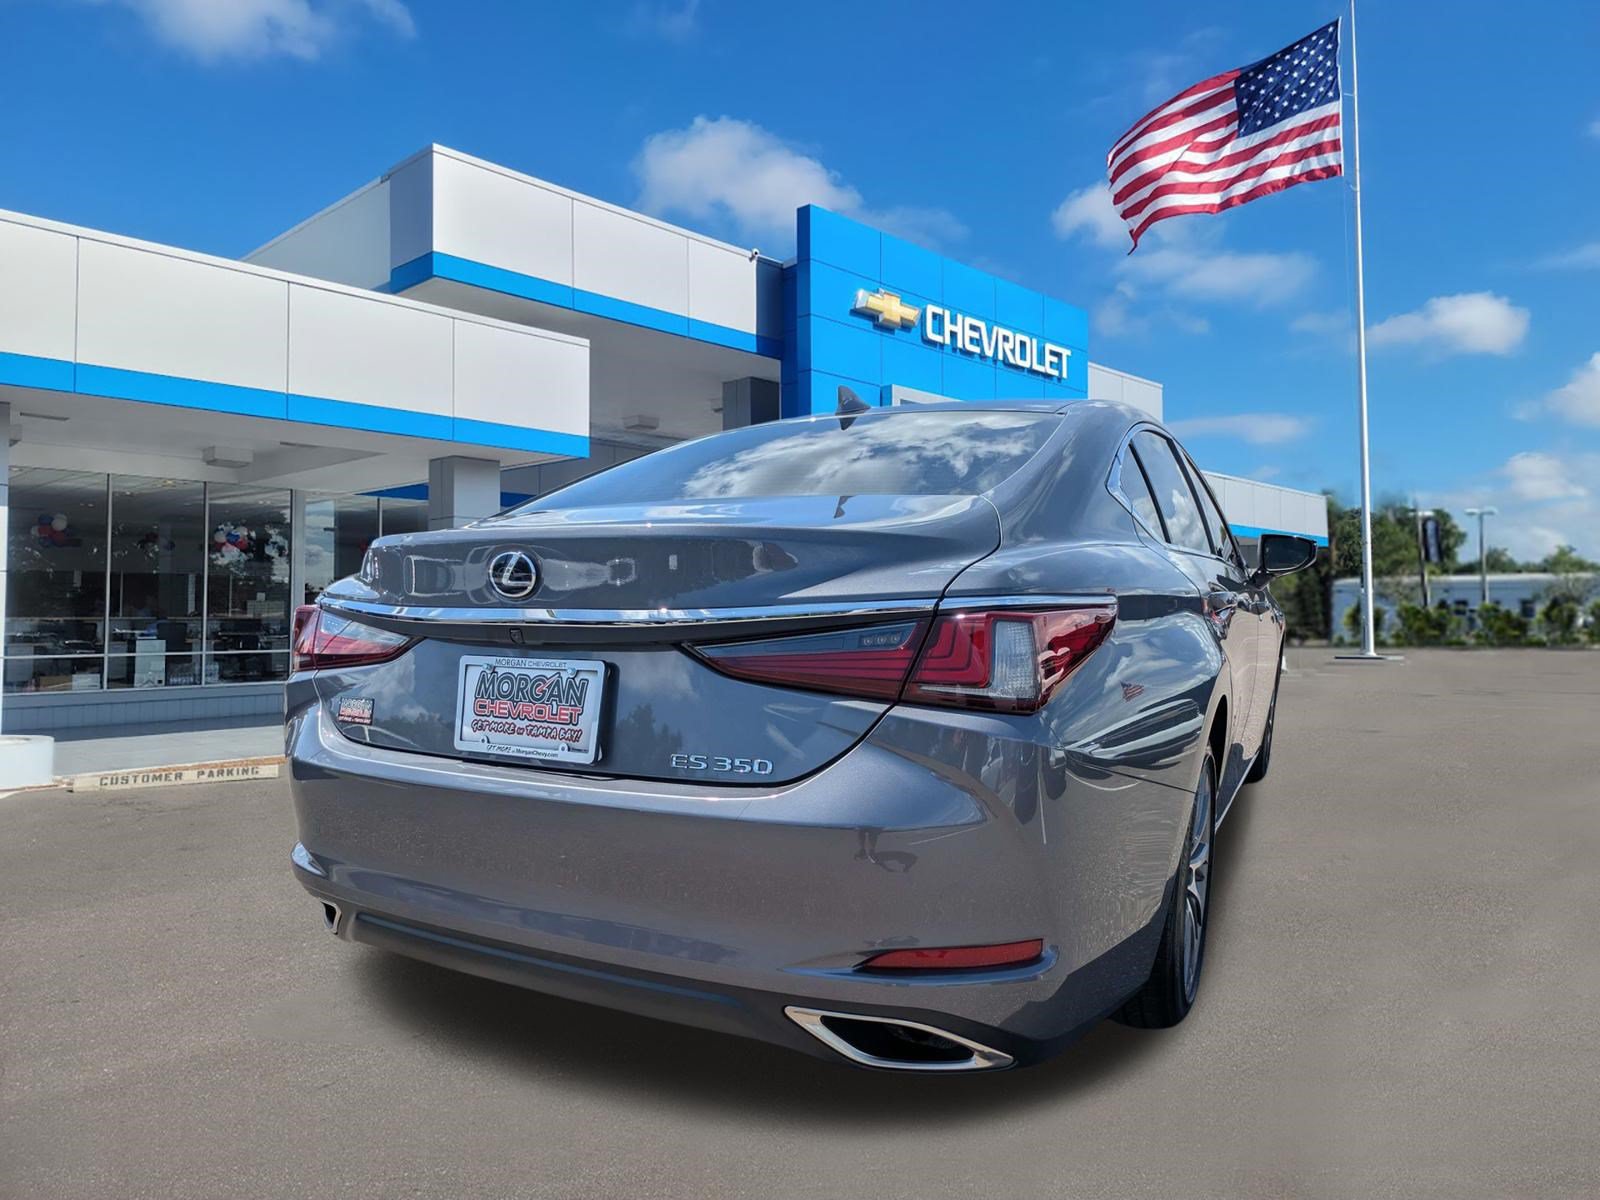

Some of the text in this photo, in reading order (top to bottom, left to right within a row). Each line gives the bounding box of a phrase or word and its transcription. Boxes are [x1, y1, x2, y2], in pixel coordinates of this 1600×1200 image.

[925, 304, 1072, 379] CHEVROLET
[495, 658, 527, 667] MORGAN
[474, 671, 589, 706] MORGAN
[473, 699, 583, 725] CHEVROLET
[471, 719, 490, 732] GET
[490, 721, 516, 735] MORE
[525, 725, 557, 740] TAMPA
[558, 729, 583, 742] BAY!
[671, 753, 773, 775] ES 350
[100, 766, 260, 786] CUSTOMER PARKING
